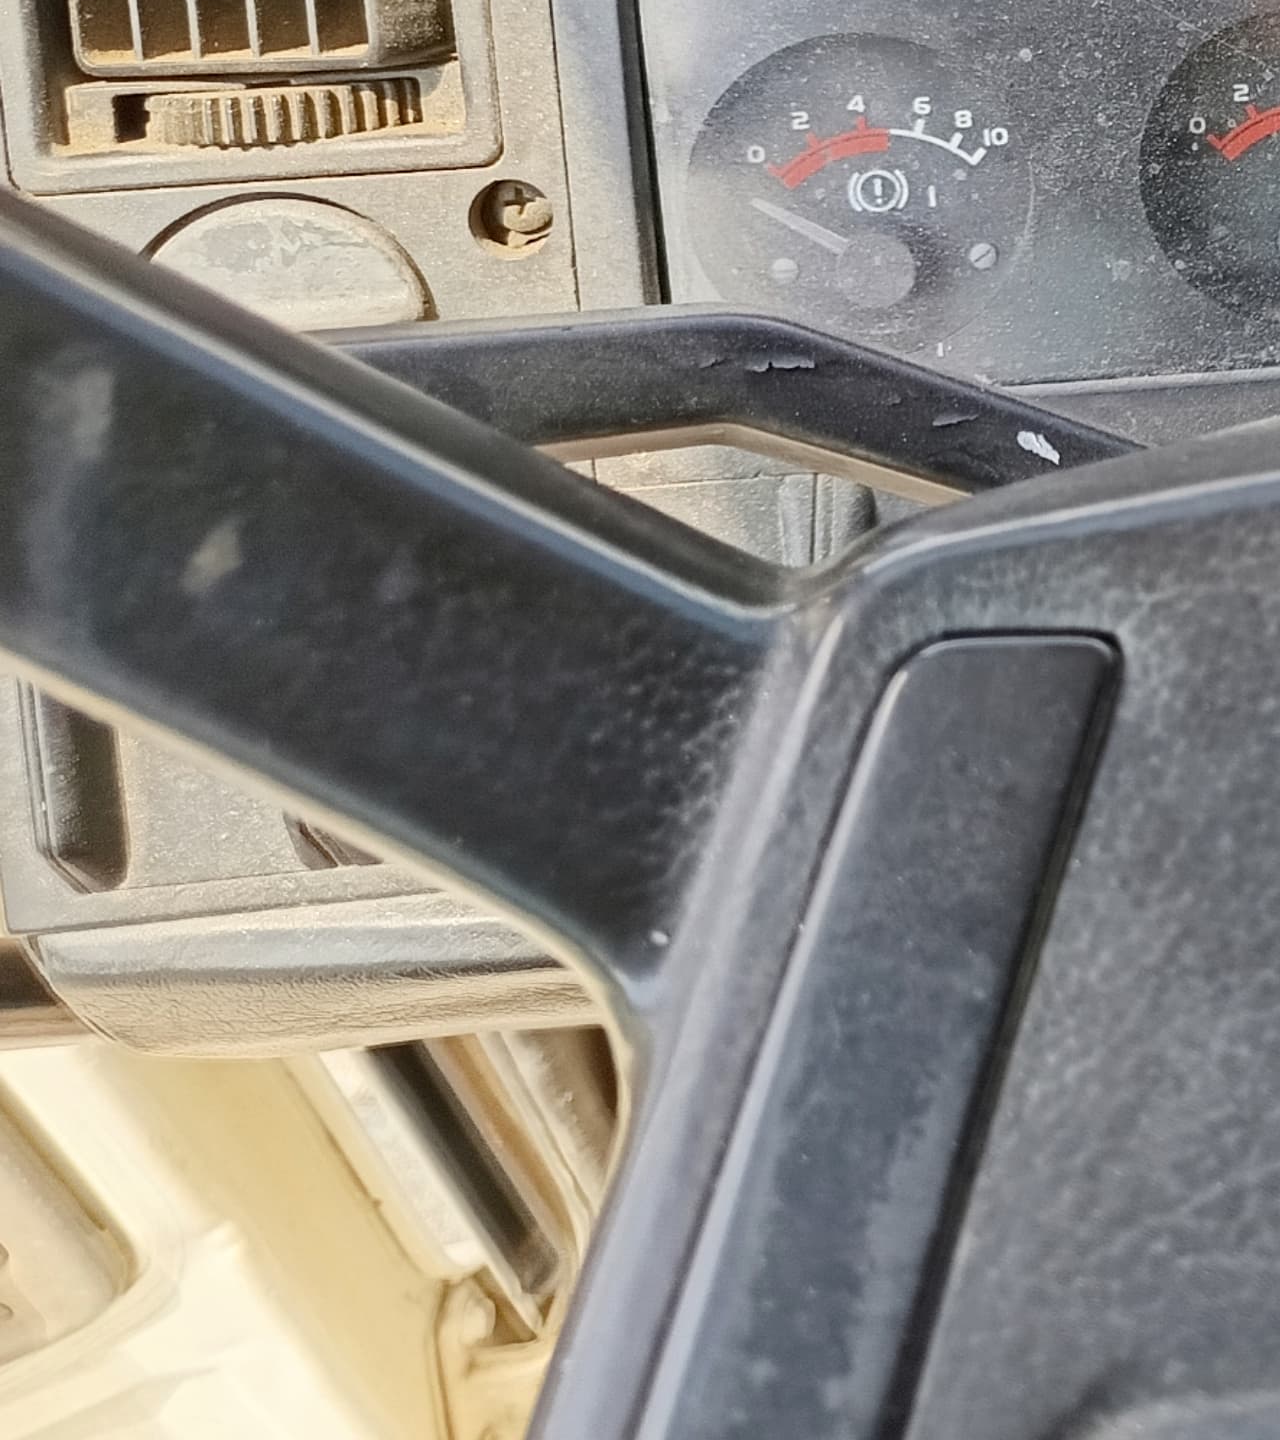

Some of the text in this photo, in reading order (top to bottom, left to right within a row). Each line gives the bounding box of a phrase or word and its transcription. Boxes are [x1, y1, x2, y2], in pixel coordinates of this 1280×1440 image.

[1233, 84, 1249, 102] 2
[847, 95, 865, 112] 4
[913, 96, 931, 114] 6
[790, 111, 810, 130] 2
[954, 110, 972, 128] 8
[1189, 116, 1206, 134] 0
[983, 127, 1008, 147] 10
[747, 145, 765, 163] 0
